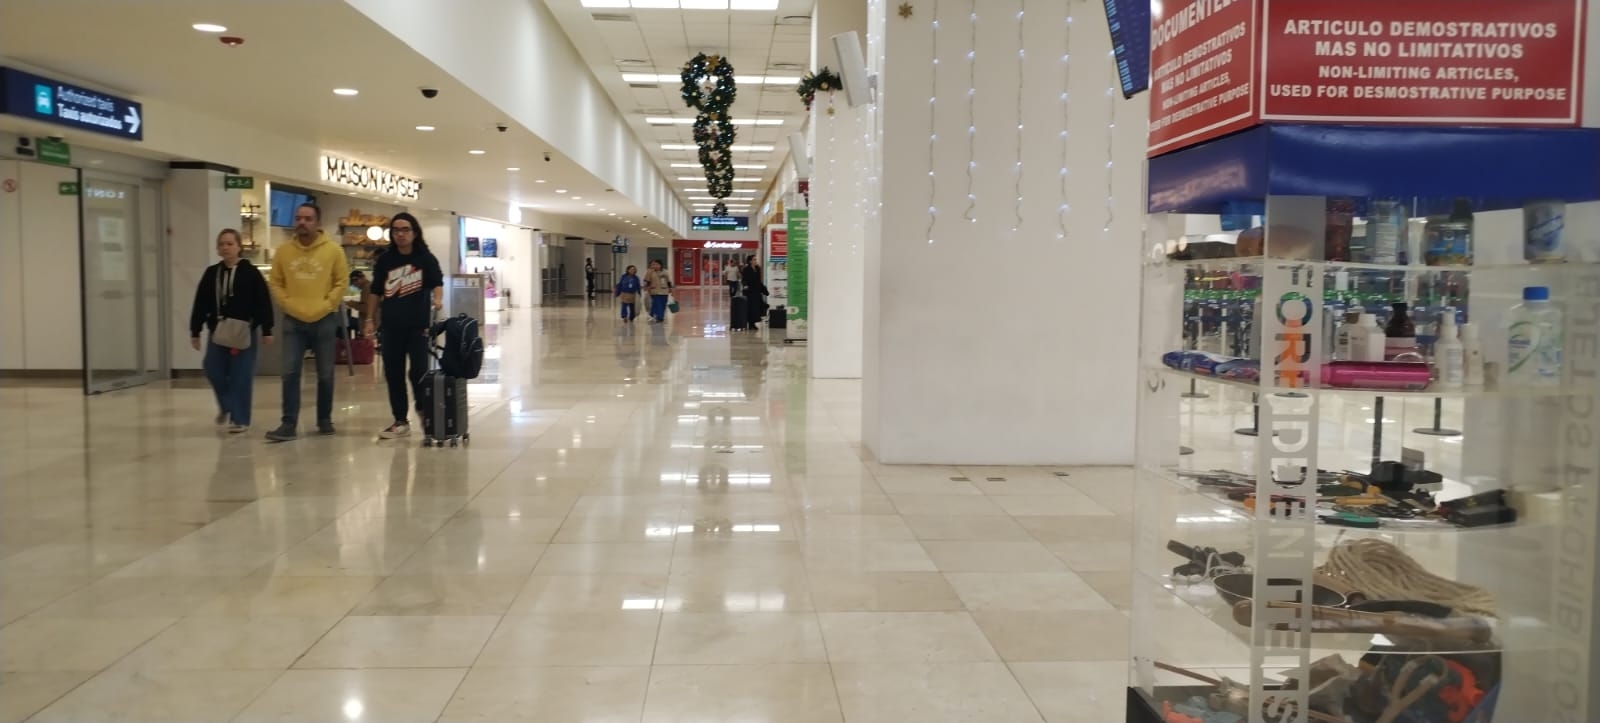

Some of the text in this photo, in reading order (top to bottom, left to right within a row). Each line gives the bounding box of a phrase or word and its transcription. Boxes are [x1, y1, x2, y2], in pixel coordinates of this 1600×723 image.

[1283, 19, 1557, 38] ARTICULO DEMOSTRATIVOS
[1315, 41, 1523, 59] MAS NO LIMITATIVOS
[1319, 65, 1519, 83] NON-LIMITING ARTICLES,
[1270, 84, 1566, 100] USED FOR DESMOSTRATIVE PURPOSE
[322, 154, 379, 189] MAISON
[1261, 578, 1303, 723] ITEMS
